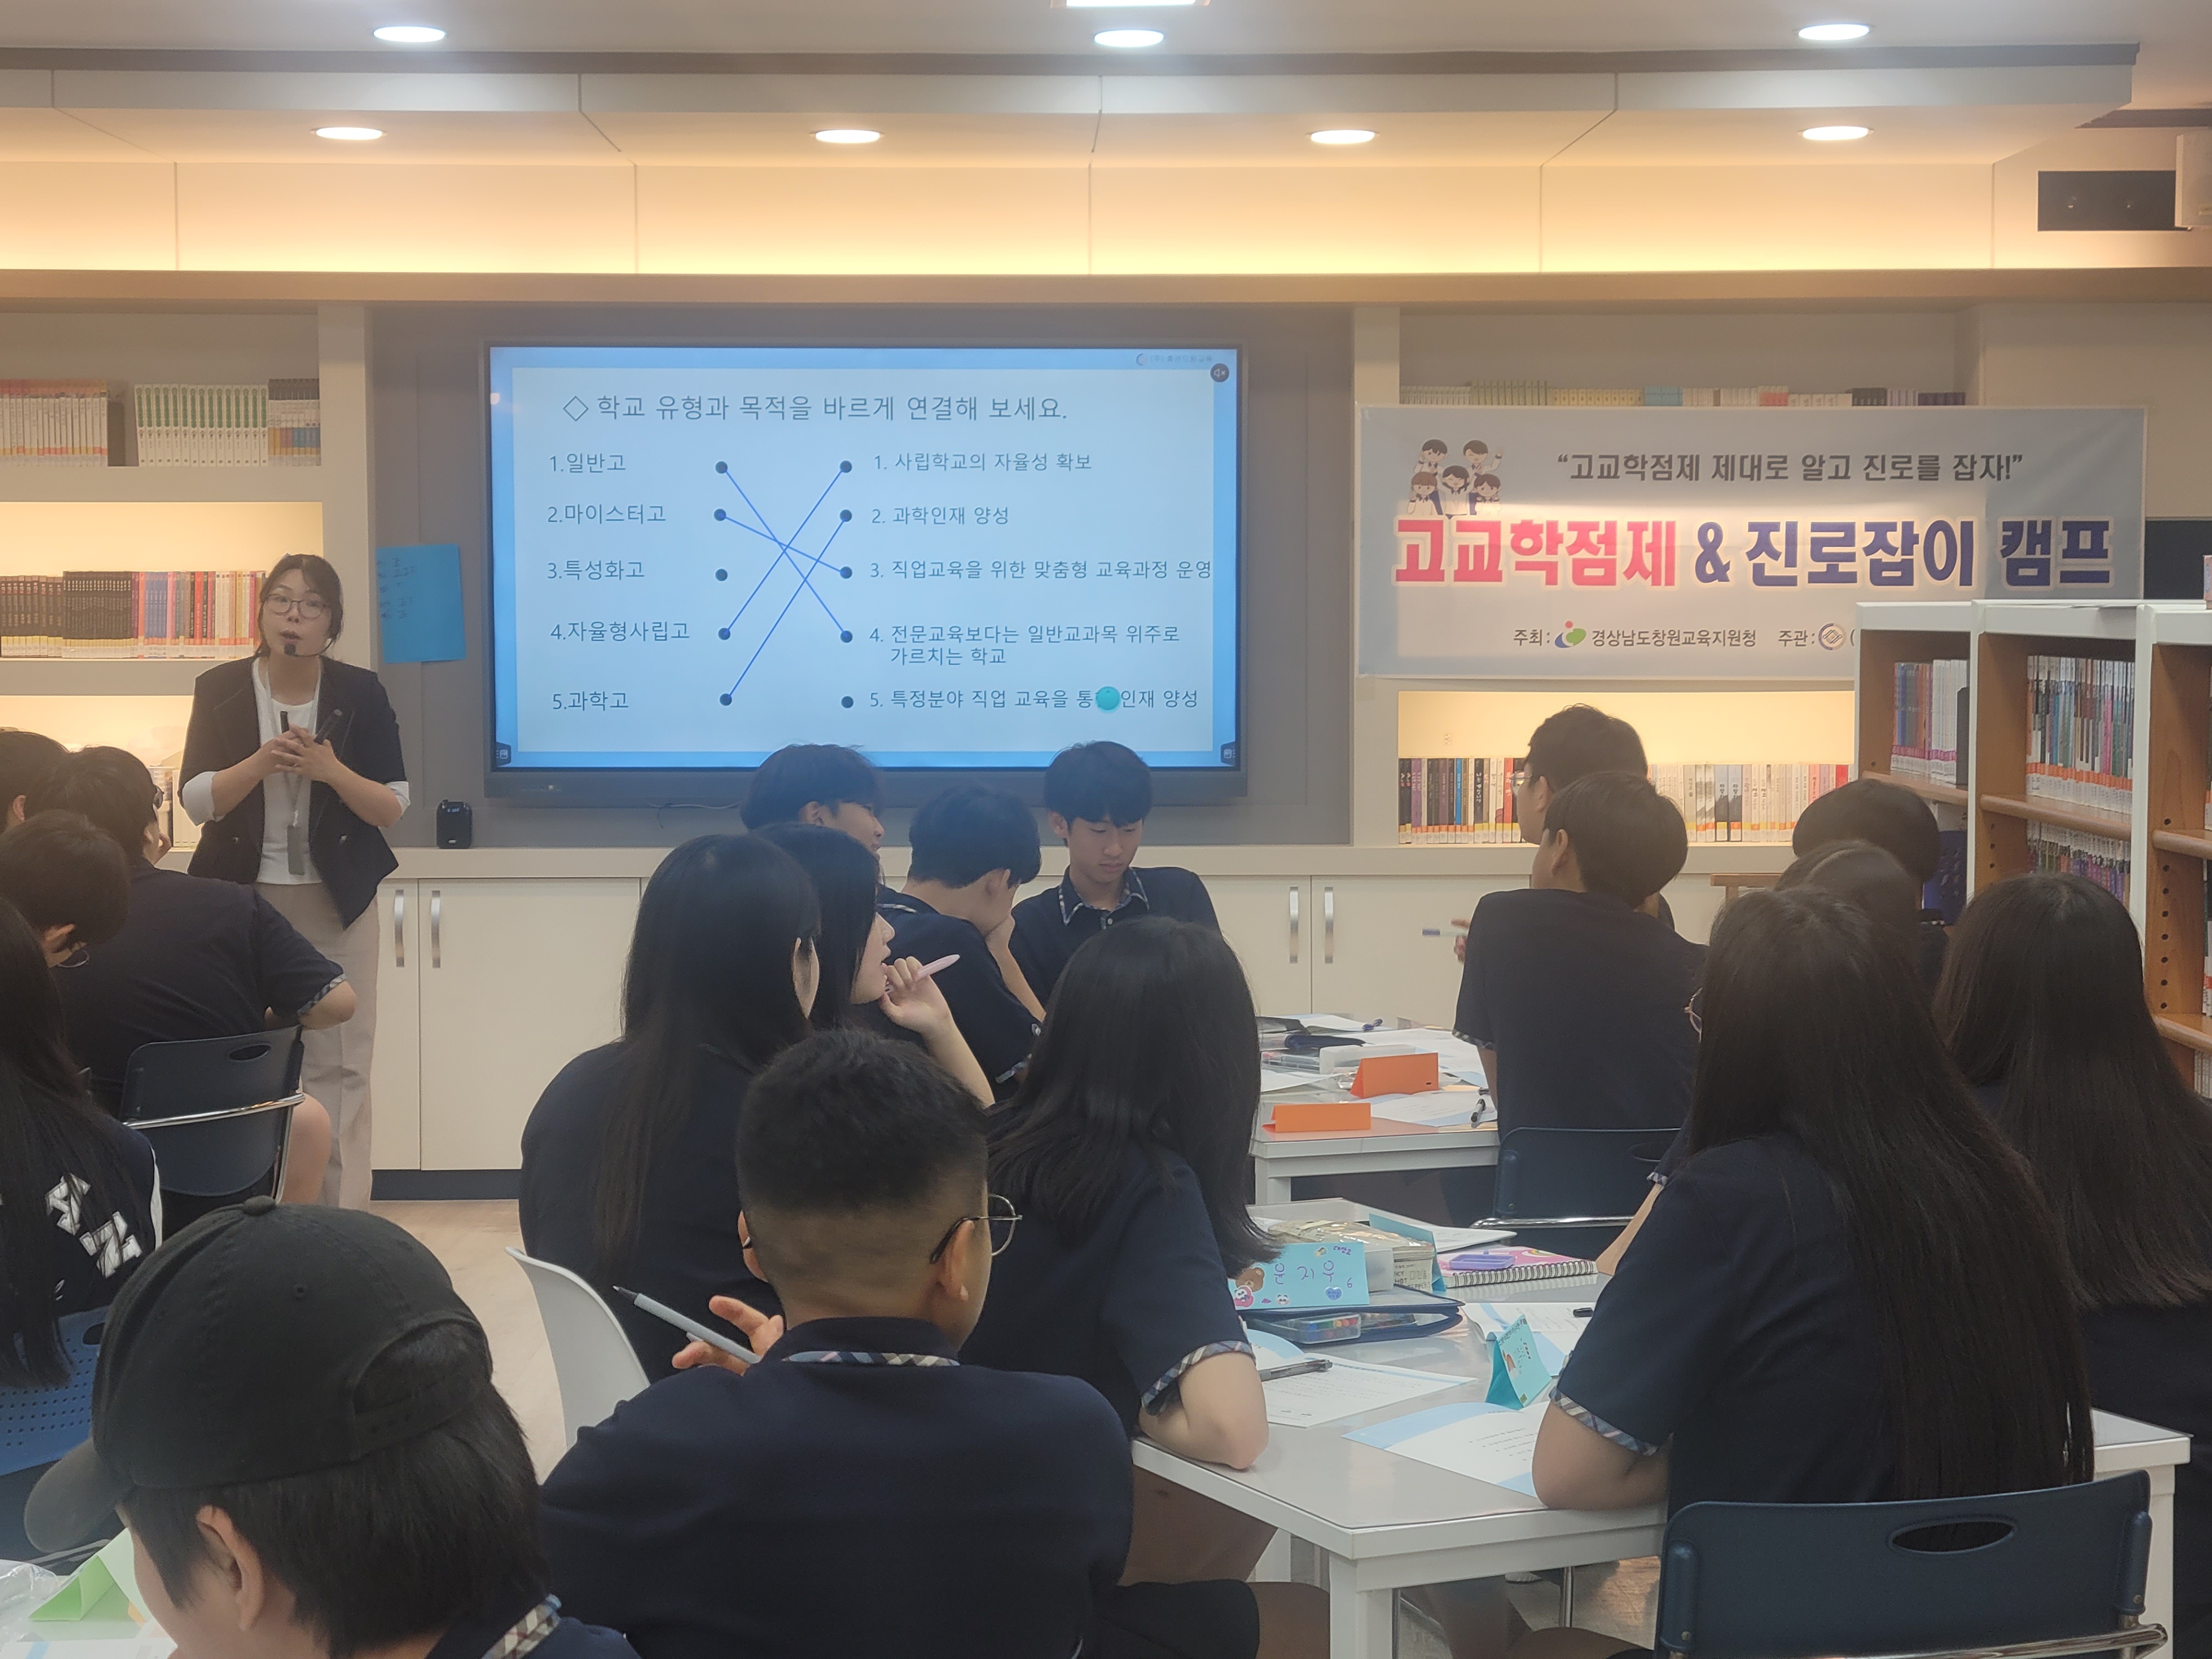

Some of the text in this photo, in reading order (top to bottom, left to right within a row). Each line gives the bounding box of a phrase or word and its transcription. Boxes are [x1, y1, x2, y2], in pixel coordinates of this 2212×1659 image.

[597, 396, 1066, 421] 학교 유형과 목적을 바르게 연결해 보세요.
[874, 453, 1092, 471] 1. 사립학교의 자율성 확보
[1711, 454, 1788, 481] 제대로
[1802, 454, 1851, 481] 알고
[1863, 455, 1940, 481] 진로를
[872, 507, 1008, 525] 2. 과학인재 양성
[1395, 519, 2110, 586] 고교학점제 & 진로잡이 캠프
[870, 561, 1210, 579] 3. 직업교육을 위한 맞춤형 교육과정 운영
[870, 625, 1180, 644] 4. 전문교육보다는 일반교과목 위주로
[1592, 630, 1756, 647] 경상남도창원교육지원청
[891, 647, 1006, 665] 가르치는 학교
[870, 692, 883, 707] 5.
[891, 690, 963, 708] 특정분야
[972, 690, 1005, 708] 직업
[1014, 690, 1068, 708] 교육을
[1121, 690, 1154, 708] 인재
[1164, 690, 1197, 708] 양성
